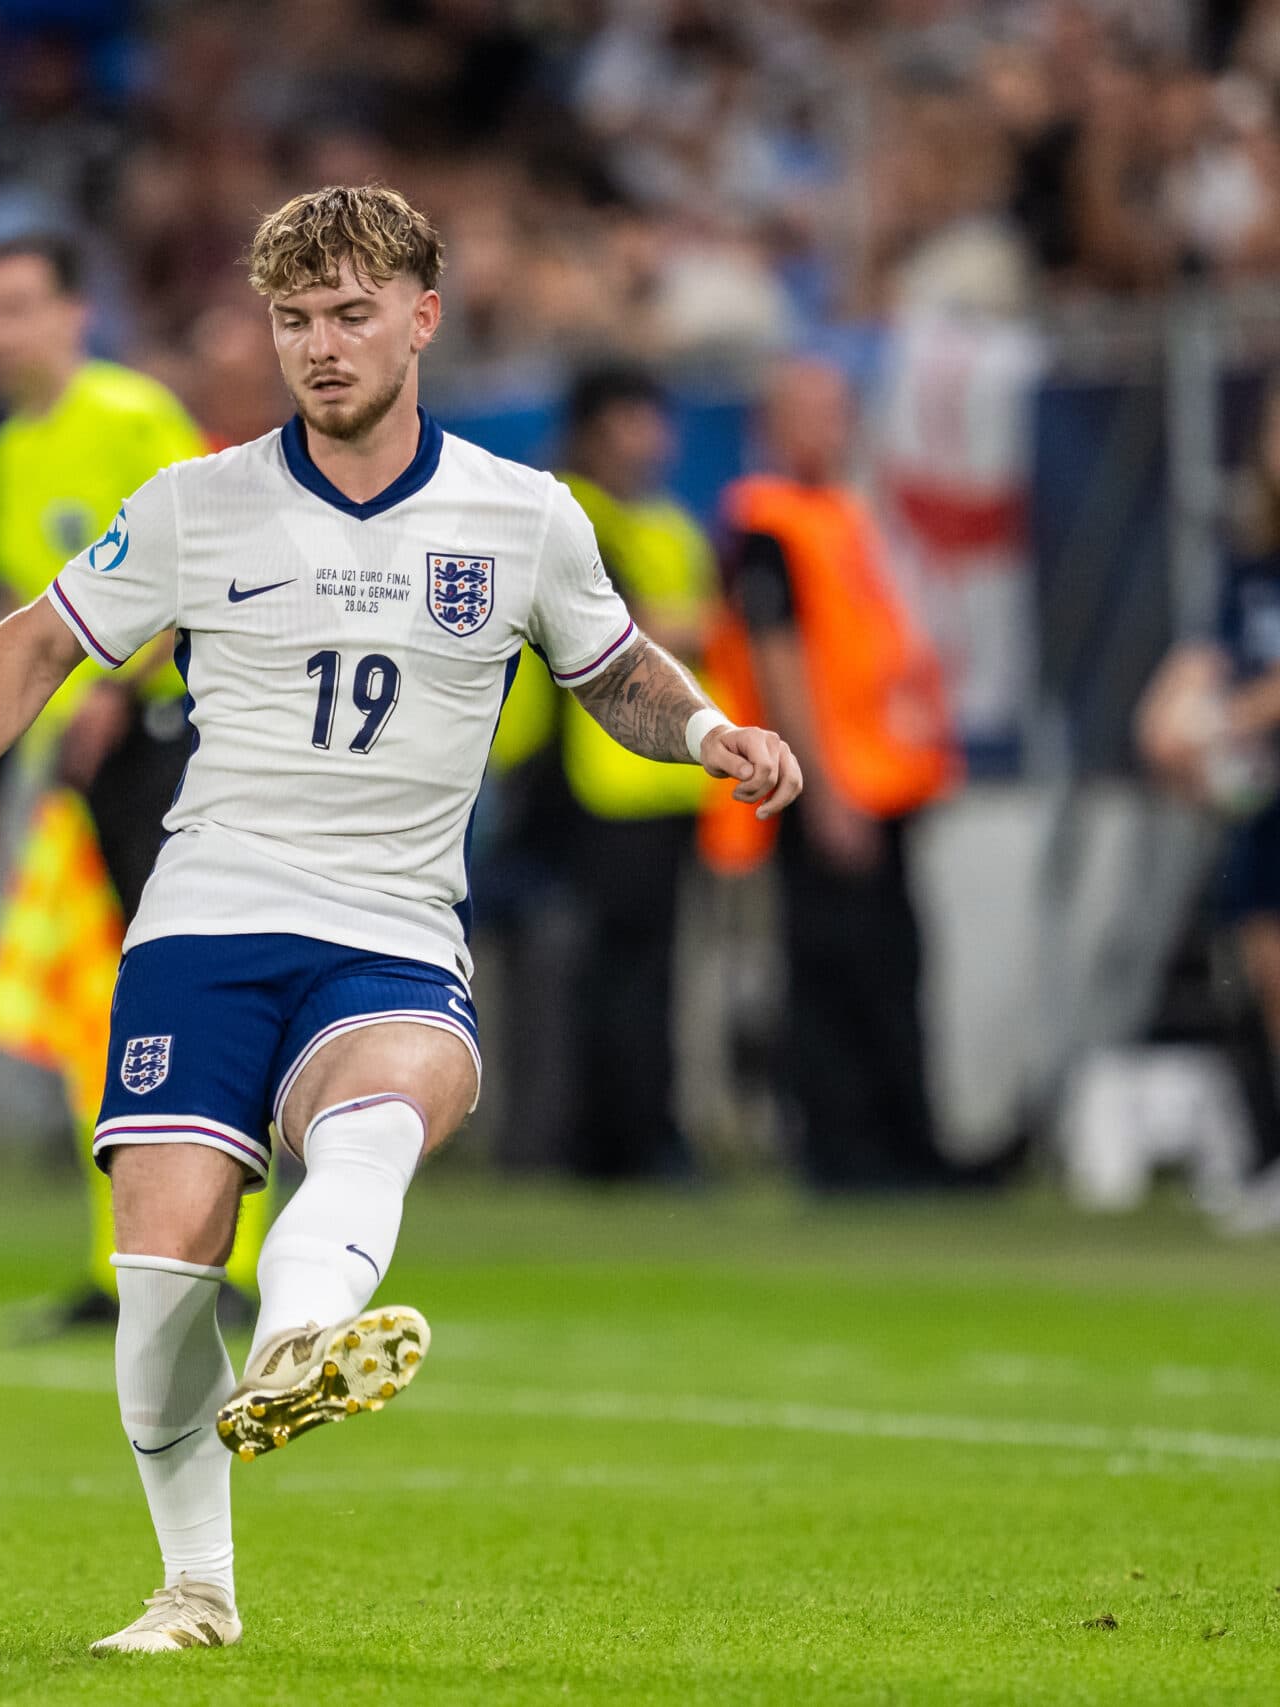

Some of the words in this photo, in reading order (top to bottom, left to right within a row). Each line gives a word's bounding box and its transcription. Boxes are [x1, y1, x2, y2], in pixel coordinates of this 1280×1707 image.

[316, 568, 337, 580] UEFA
[341, 569, 356, 582] U21
[360, 570, 383, 583] EURO
[386, 572, 411, 586] FINAL
[316, 583, 357, 597] ENGLAND
[368, 586, 410, 602] GERMANY
[345, 599, 379, 613] 28.06.25
[307, 650, 401, 754] 19
